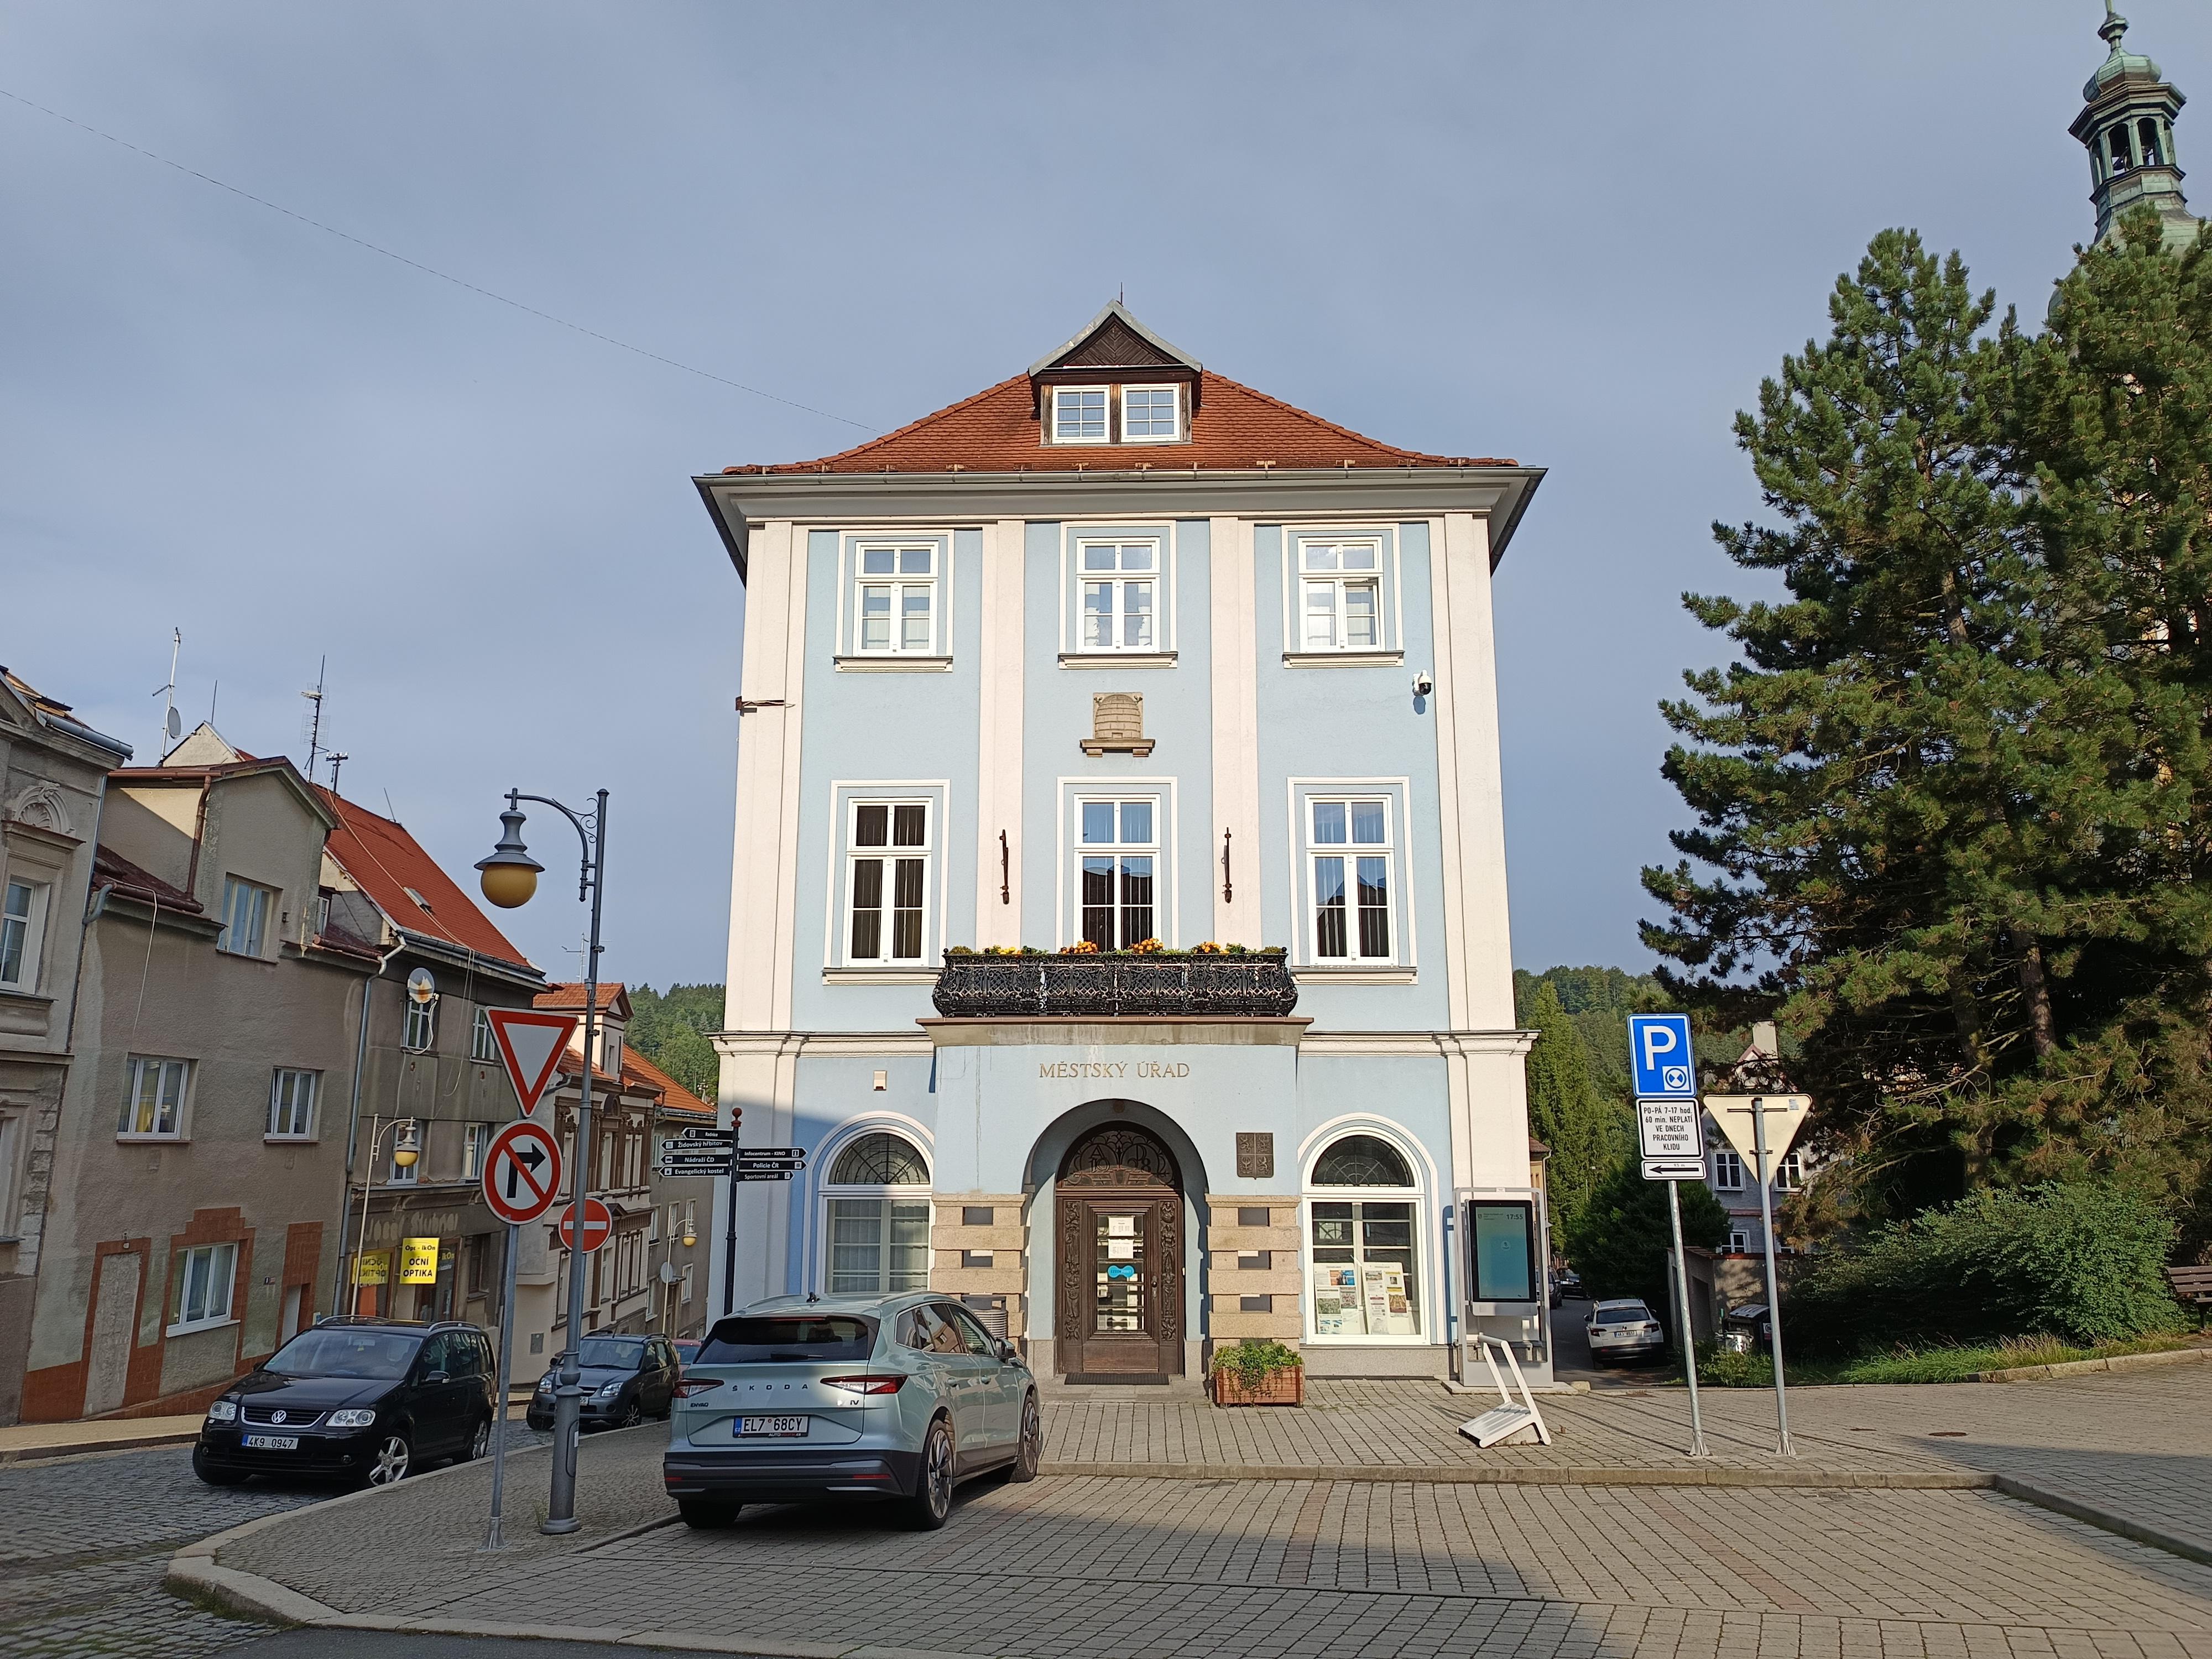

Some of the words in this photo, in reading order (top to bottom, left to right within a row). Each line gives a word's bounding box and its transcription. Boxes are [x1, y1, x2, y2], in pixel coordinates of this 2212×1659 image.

[1643, 1025, 1677, 1070] P
[1040, 1061, 1128, 1078] MĚSTSKÝ
[1137, 1061, 1190, 1078] ÚŘAD
[1644, 1105, 1662, 1114] PO-PÁ
[1670, 1114, 1693, 1123] NEPLATÍ
[1653, 1133, 1688, 1141] PRACOVNÍHO
[409, 1256, 429, 1265] OČNÍ
[743, 1418, 765, 1432] EL7
[774, 1418, 802, 1431] 68CY
[249, 1437, 265, 1447] 4K9
[271, 1438, 294, 1448] 0947
